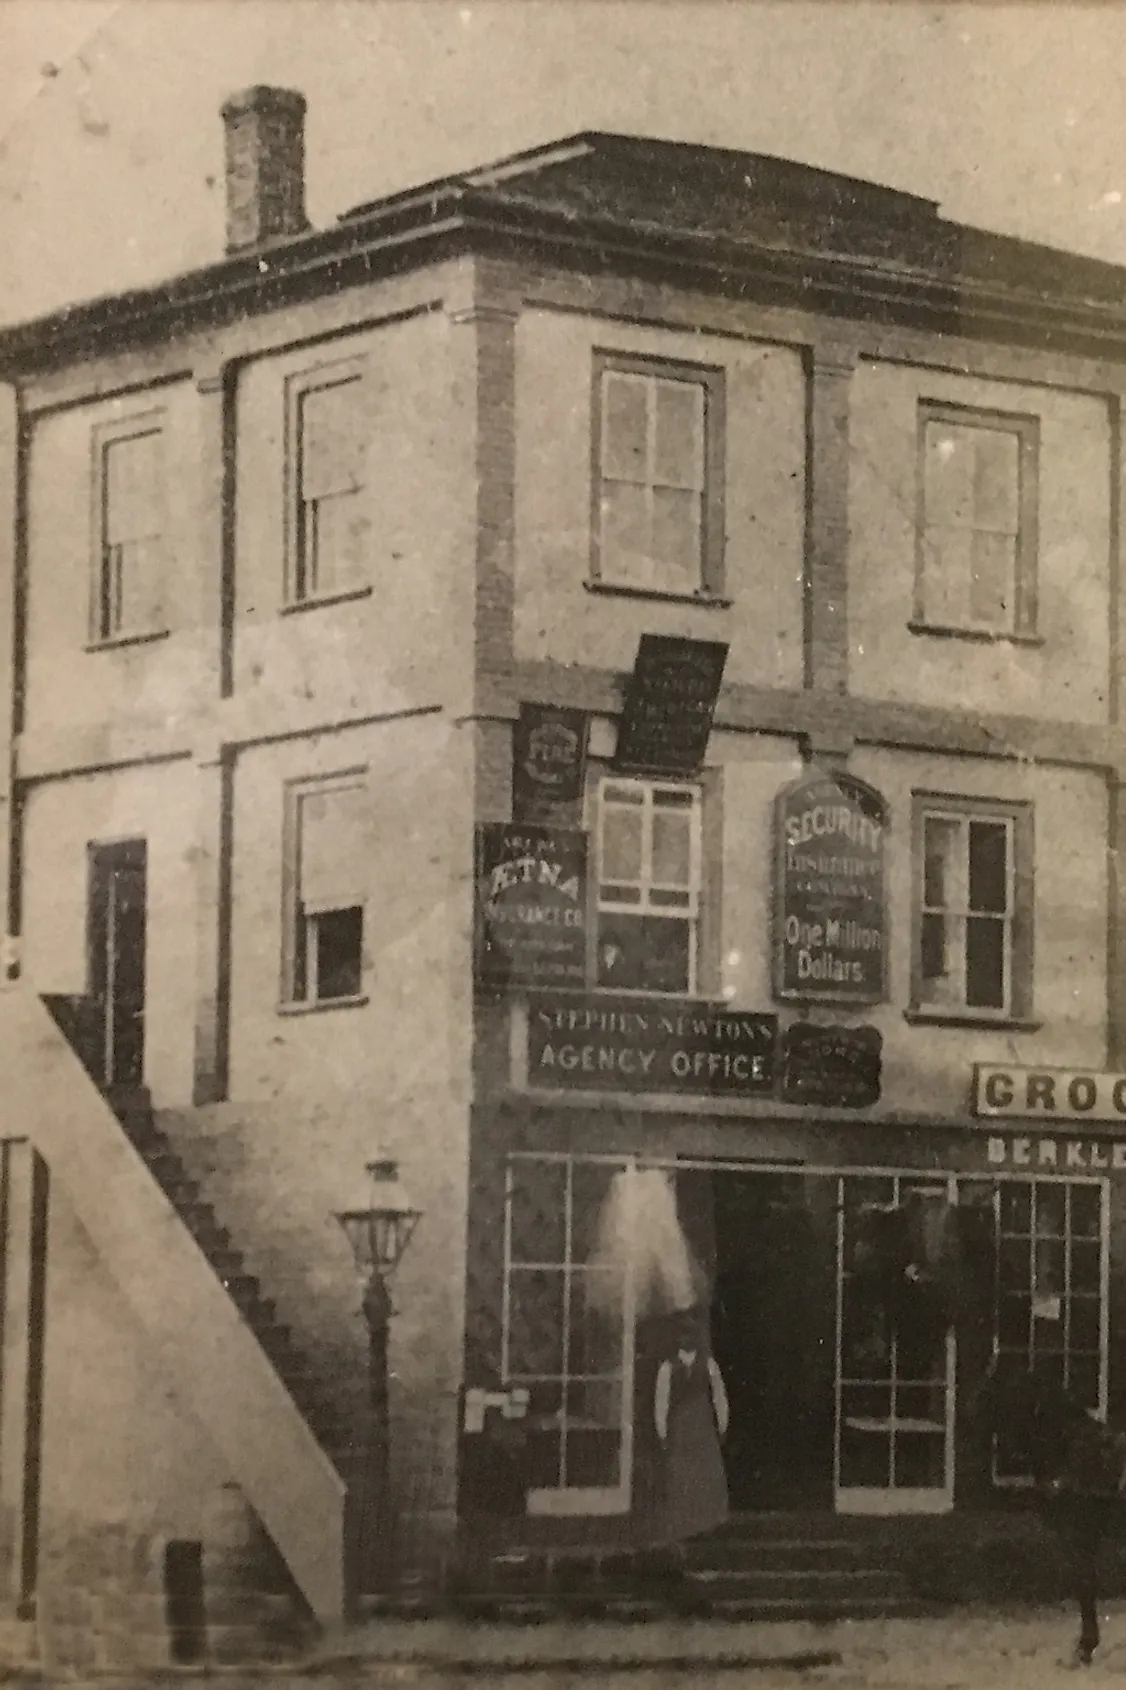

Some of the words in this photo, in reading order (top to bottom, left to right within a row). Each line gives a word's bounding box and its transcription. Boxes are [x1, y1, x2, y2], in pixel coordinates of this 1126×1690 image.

[785, 805, 882, 852] SECURITY
[785, 915, 823, 949] One
[826, 918, 881, 950] Million
[798, 949, 864, 983] Dollars
[540, 1044, 656, 1073] AGENCY
[671, 1051, 771, 1081] OFFICE.
